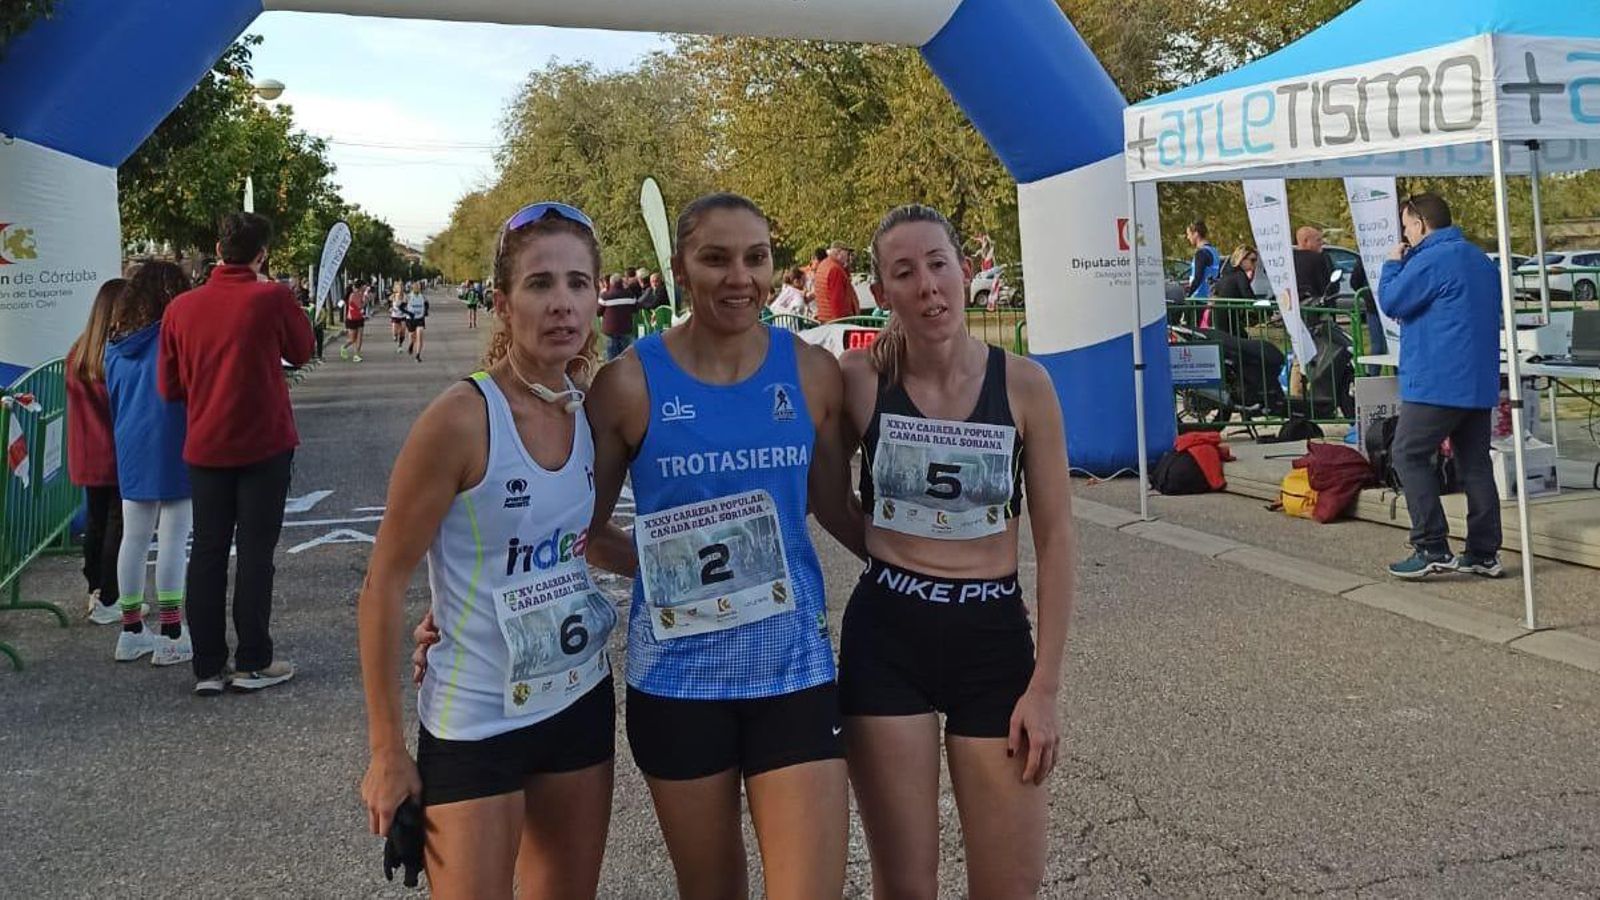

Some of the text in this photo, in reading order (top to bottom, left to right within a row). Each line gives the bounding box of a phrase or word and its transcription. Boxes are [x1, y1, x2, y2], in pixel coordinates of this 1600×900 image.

[13, 272, 34, 285] de
[39, 269, 97, 284] Córdoba
[886, 419, 1005, 439] XXXV CARRERA POPULAR
[889, 430, 1003, 450] CAÑADA REAL SORIANA
[656, 443, 808, 478] TROTASIERRA
[925, 463, 962, 500] 5
[644, 493, 764, 530] XXXV CARRERA POPULAR
[650, 504, 764, 539] CAÑADA REAL SORIANA
[536, 572, 573, 592] CARRERA
[698, 543, 735, 586] 2
[877, 567, 955, 603] NIKE
[561, 614, 589, 655] 6
